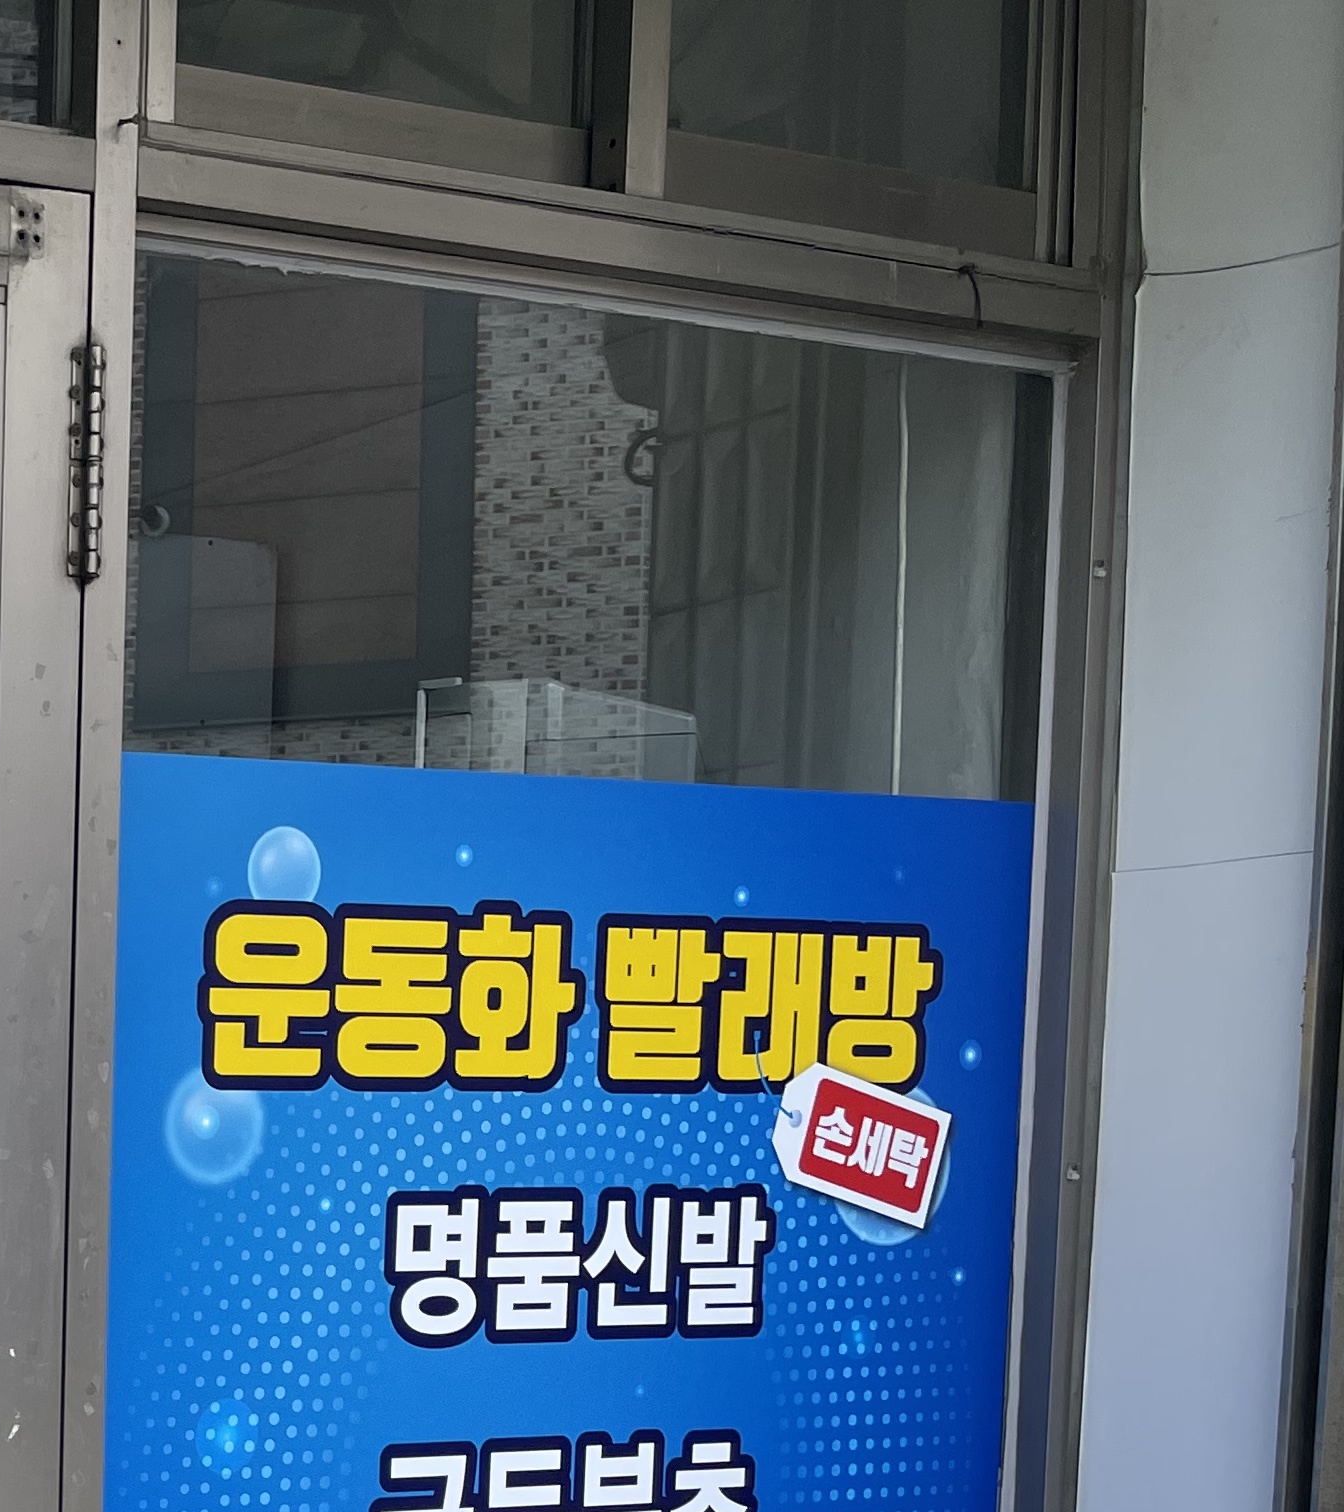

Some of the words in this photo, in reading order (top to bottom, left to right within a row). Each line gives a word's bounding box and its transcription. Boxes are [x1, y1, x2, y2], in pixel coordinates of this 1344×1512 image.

[207, 913, 577, 1081] 운동화
[605, 926, 935, 1085] 빨래방
[813, 1105, 931, 1189] 손세탁
[392, 1193, 769, 1337] 명품신발
